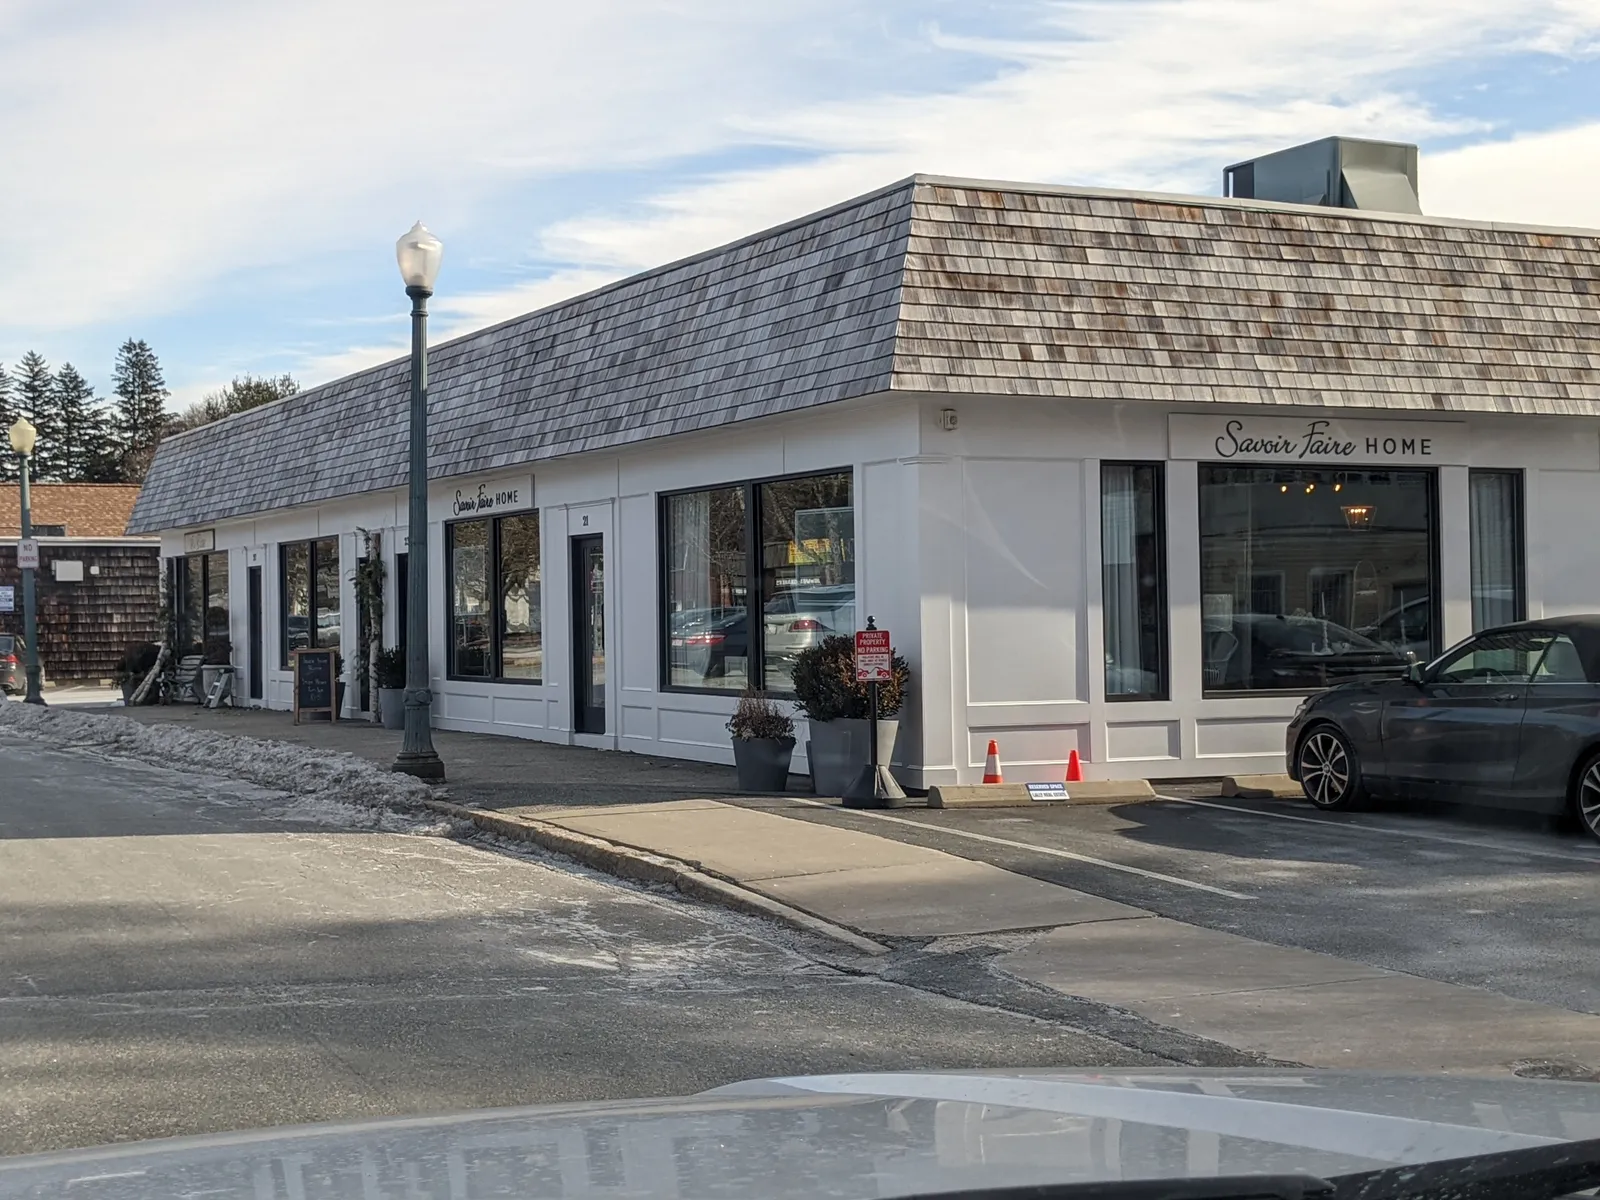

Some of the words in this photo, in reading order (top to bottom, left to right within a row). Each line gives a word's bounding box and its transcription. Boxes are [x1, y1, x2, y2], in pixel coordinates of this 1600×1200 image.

[1215, 420, 1297, 458] Savoir
[1299, 420, 1356, 459] Faire
[1365, 437, 1432, 455] HOME
[453, 490, 476, 516] Savoir
[476, 484, 494, 513] Faire
[496, 490, 518, 505] HOME
[582, 515, 589, 527] 21
[23, 543, 33, 552] NO
